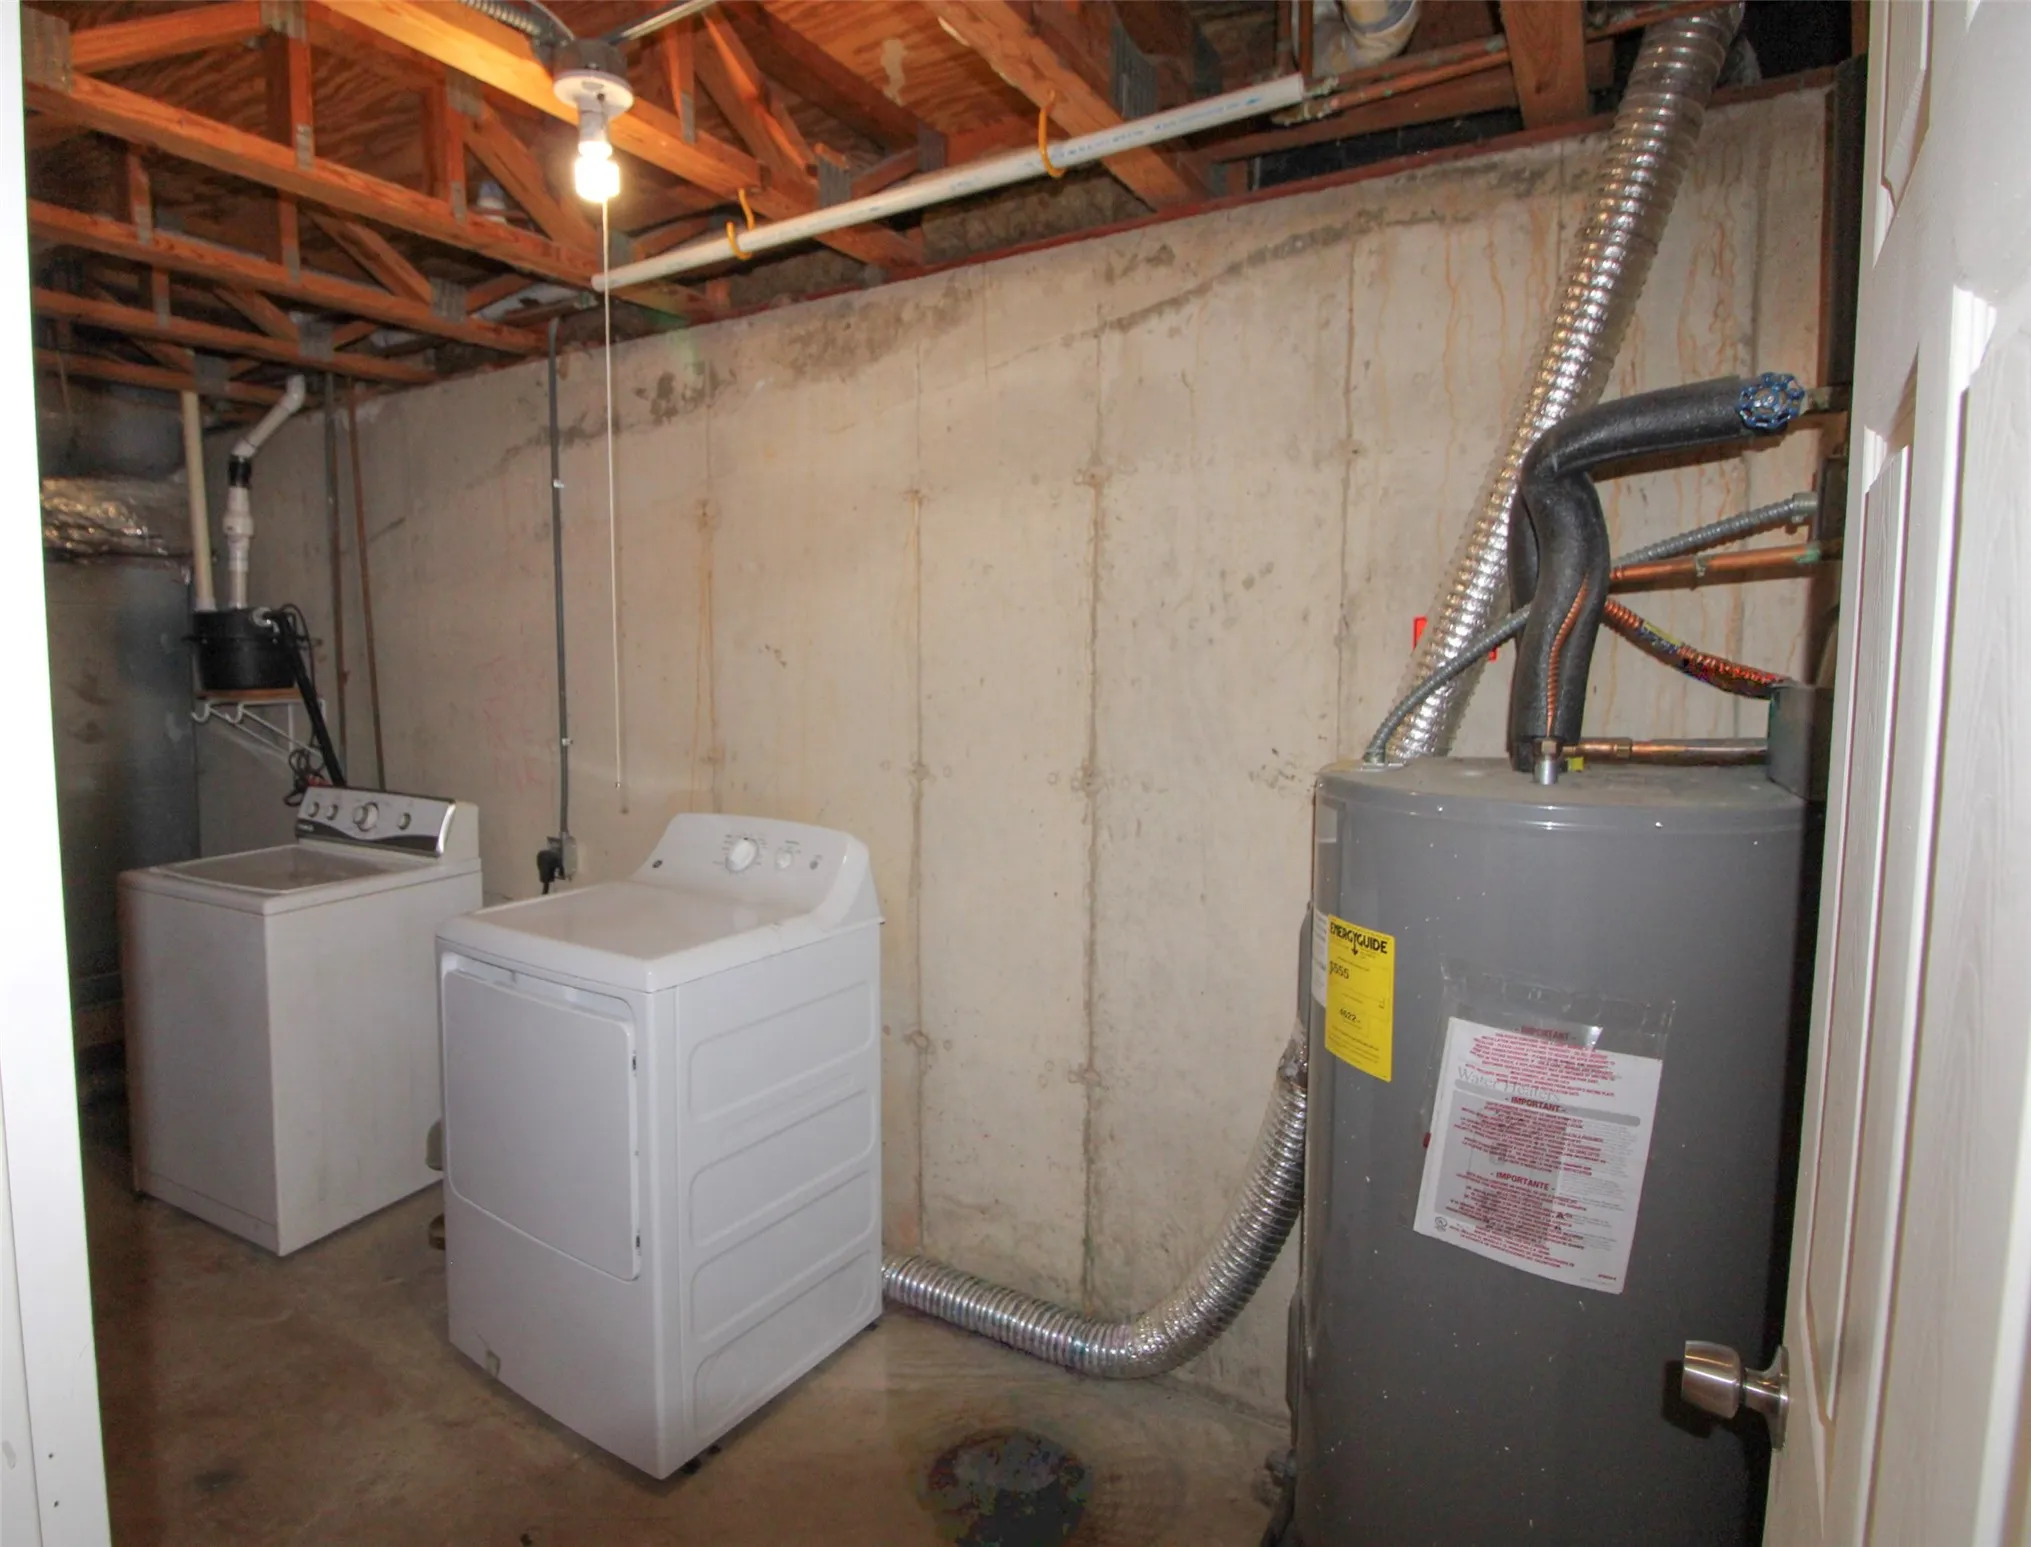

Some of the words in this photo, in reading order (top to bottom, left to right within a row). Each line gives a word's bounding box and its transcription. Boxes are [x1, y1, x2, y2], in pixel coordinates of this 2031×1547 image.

[1521, 1025, 1569, 1040] IMPORTANT
[1511, 1096, 1561, 1112] IMPORTANT
[1496, 1171, 1549, 1190] IMPORTANTE
